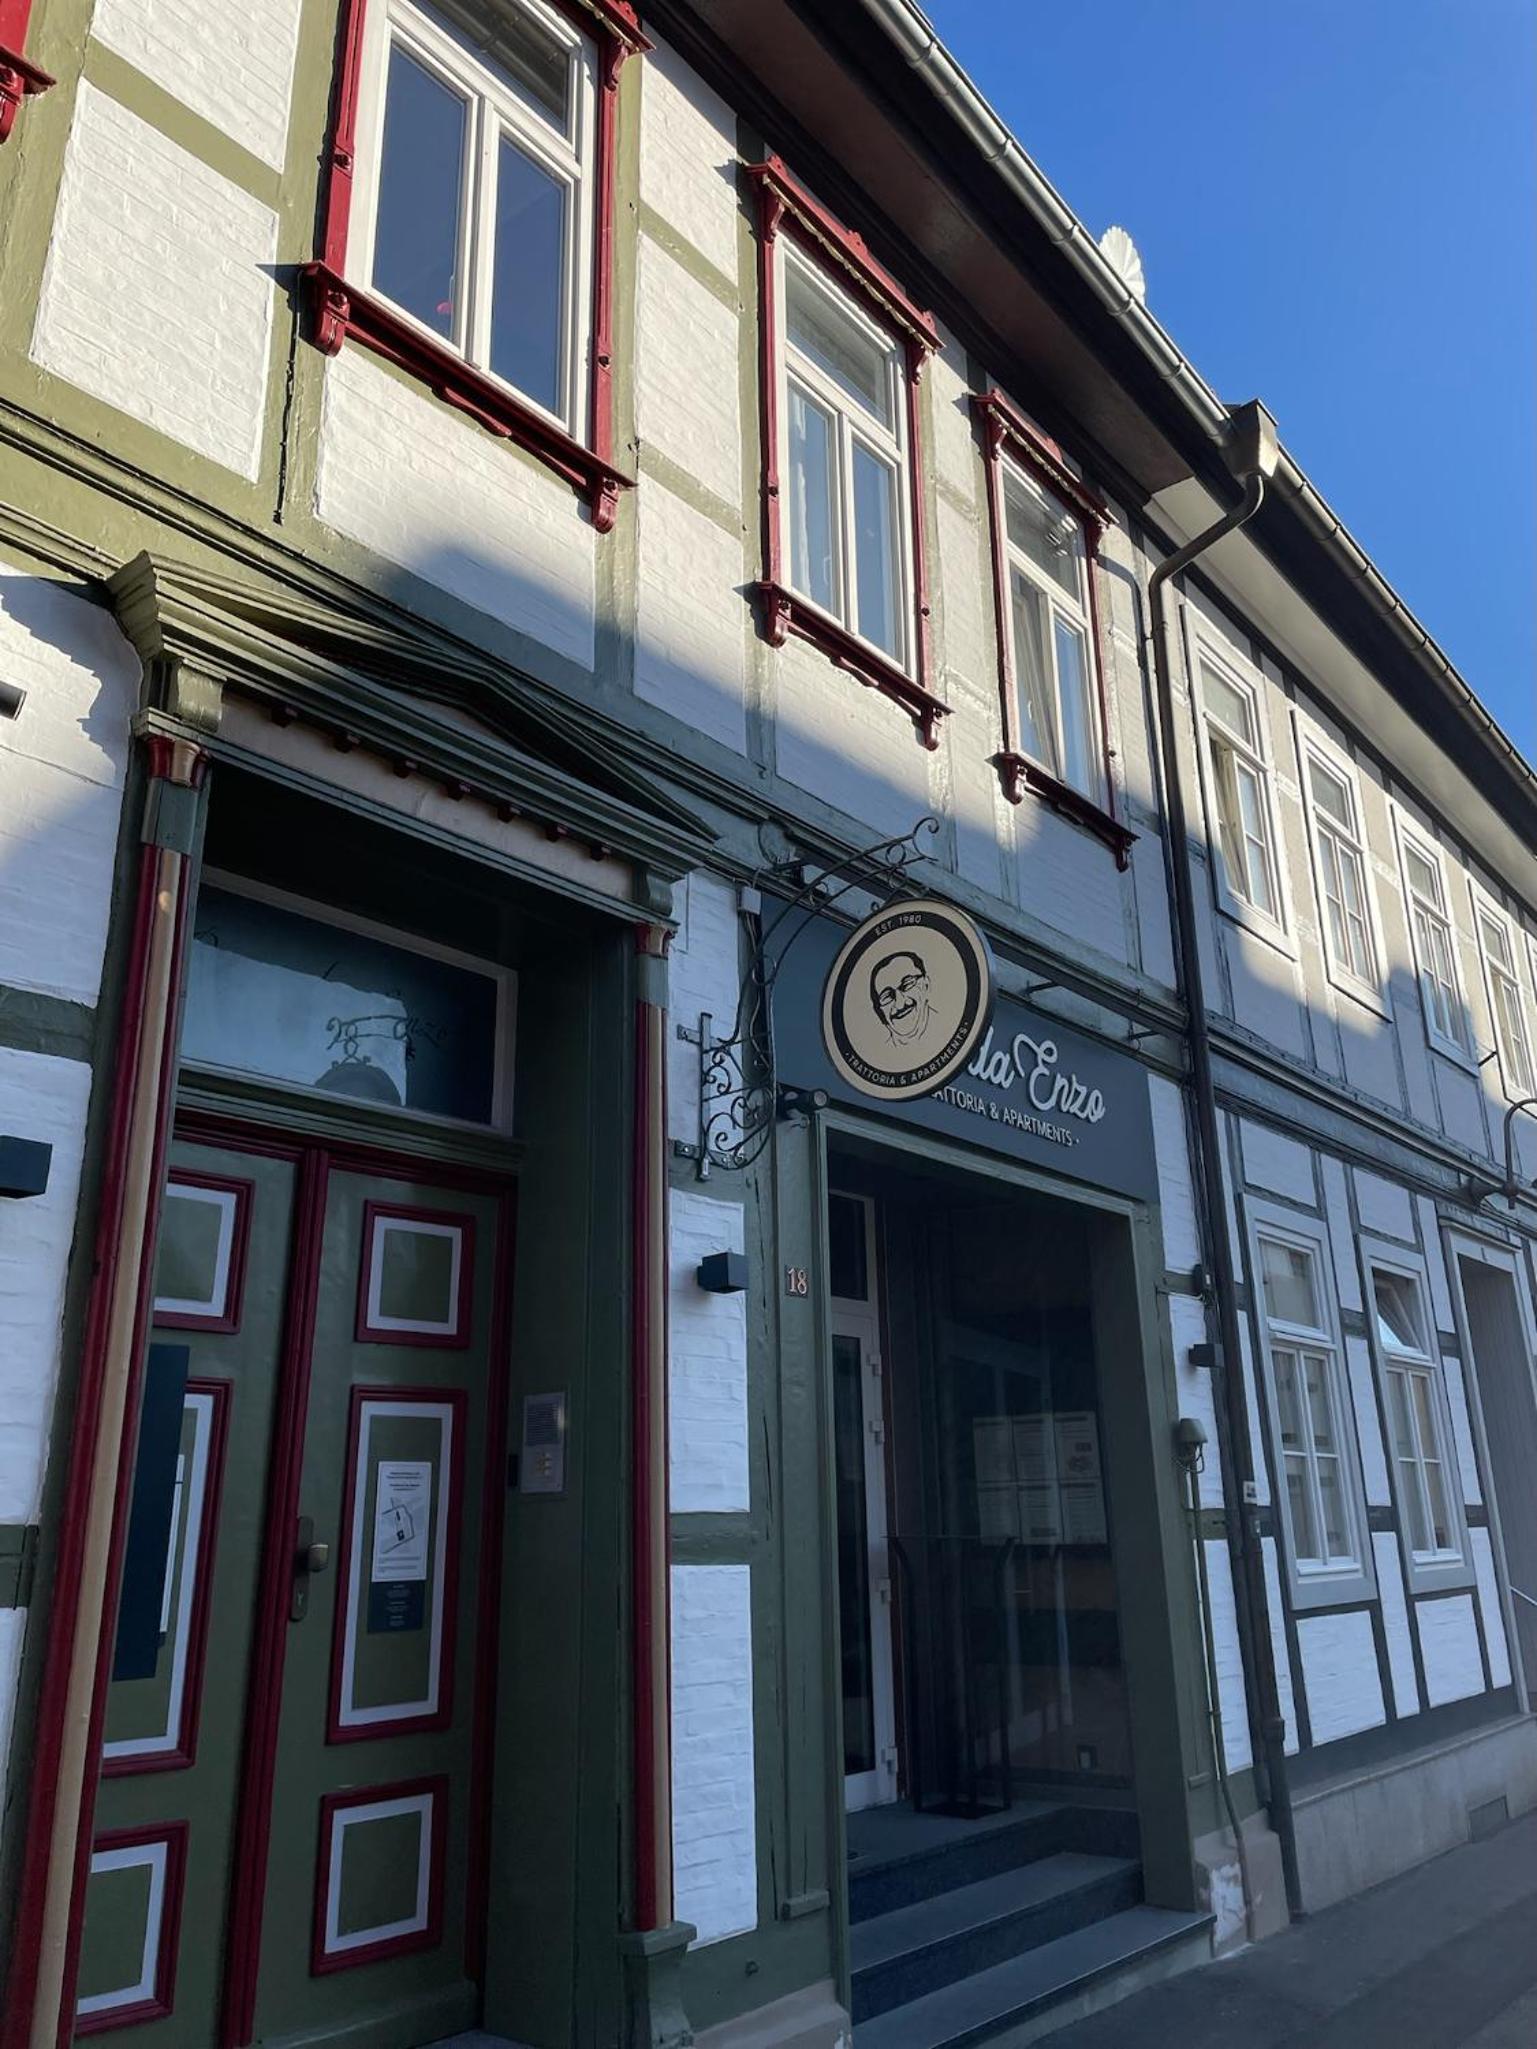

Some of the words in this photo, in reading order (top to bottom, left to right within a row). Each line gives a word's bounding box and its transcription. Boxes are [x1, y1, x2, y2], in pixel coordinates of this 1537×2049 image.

[899, 914, 922, 926] 1980
[847, 1054, 896, 1086] TRATTORIA
[899, 1075, 907, 1085] &
[911, 1026, 969, 1083] APARTMENTS
[1013, 1033, 1106, 1123] Enzo
[989, 1101, 999, 1120] &
[1003, 1107, 1073, 1147] APARTMENTS
[787, 1267, 808, 1294] 18
